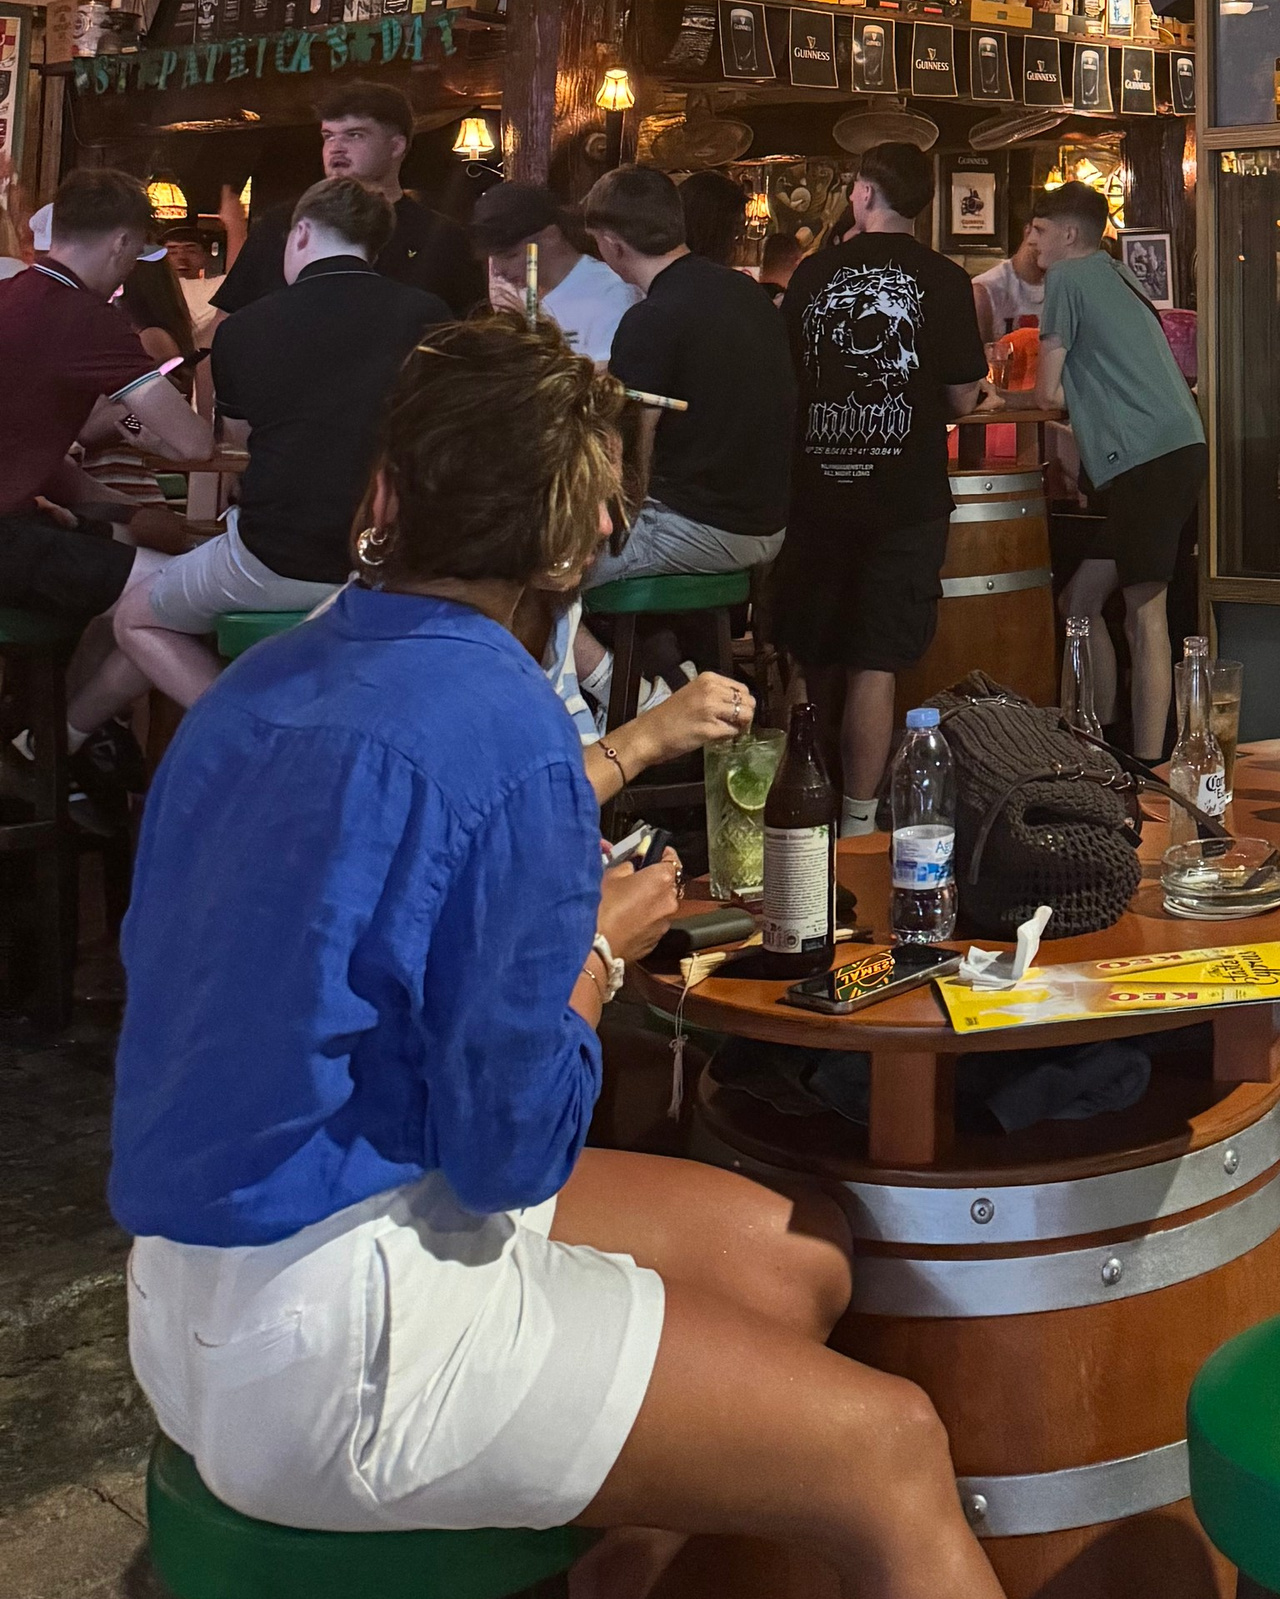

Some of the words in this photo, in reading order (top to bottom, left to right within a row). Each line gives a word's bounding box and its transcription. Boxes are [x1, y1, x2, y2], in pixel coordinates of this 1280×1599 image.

[380, 10, 460, 64] DAY
[793, 46, 831, 62] GUINNESS
[915, 58, 950, 72] GUINNESS
[1026, 70, 1058, 83] GUINNESS
[1124, 79, 1151, 92] GUINNESS
[869, 447, 892, 456] 30.84
[892, 447, 903, 456] W
[1096, 953, 1183, 972] KEO
[1108, 991, 1199, 1002] KEO
